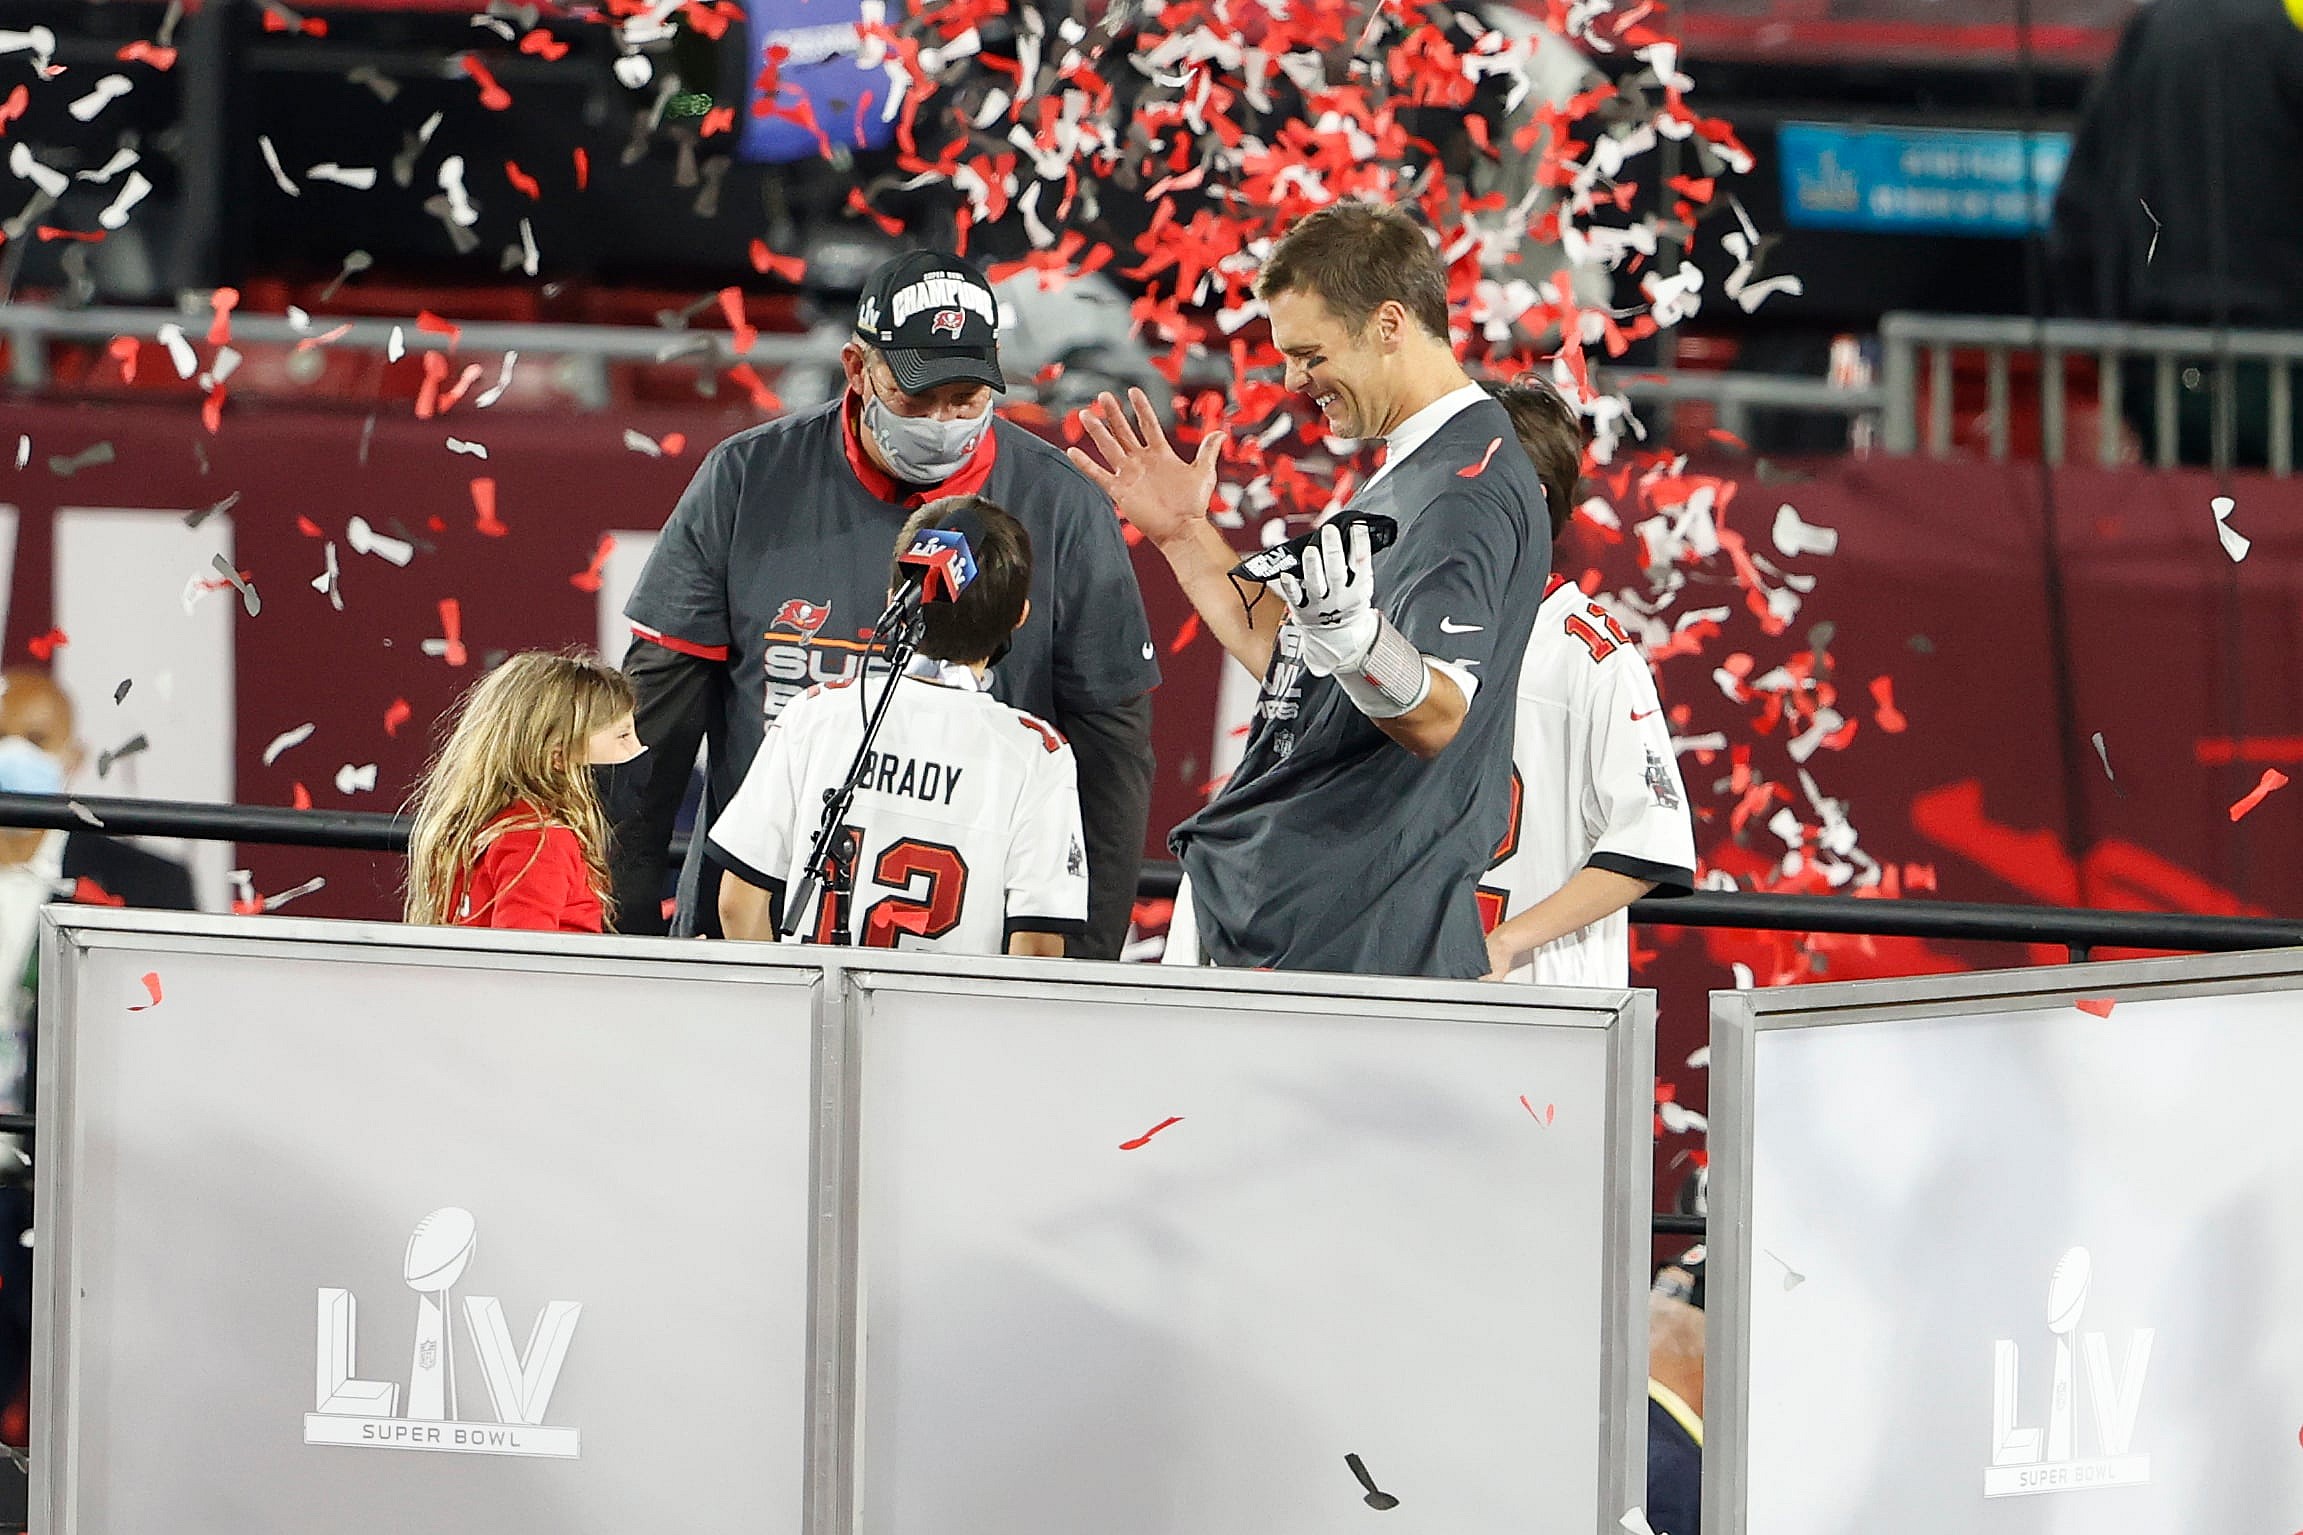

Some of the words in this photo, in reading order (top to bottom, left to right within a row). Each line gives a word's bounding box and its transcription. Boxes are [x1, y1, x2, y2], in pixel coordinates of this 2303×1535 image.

[858, 751, 963, 805] BRADY
[362, 1424, 441, 1443] SUPER
[454, 1429, 521, 1447] BOWL
[2019, 1468, 2068, 1487] SUPER
[2075, 1464, 2117, 1482] BOWL
